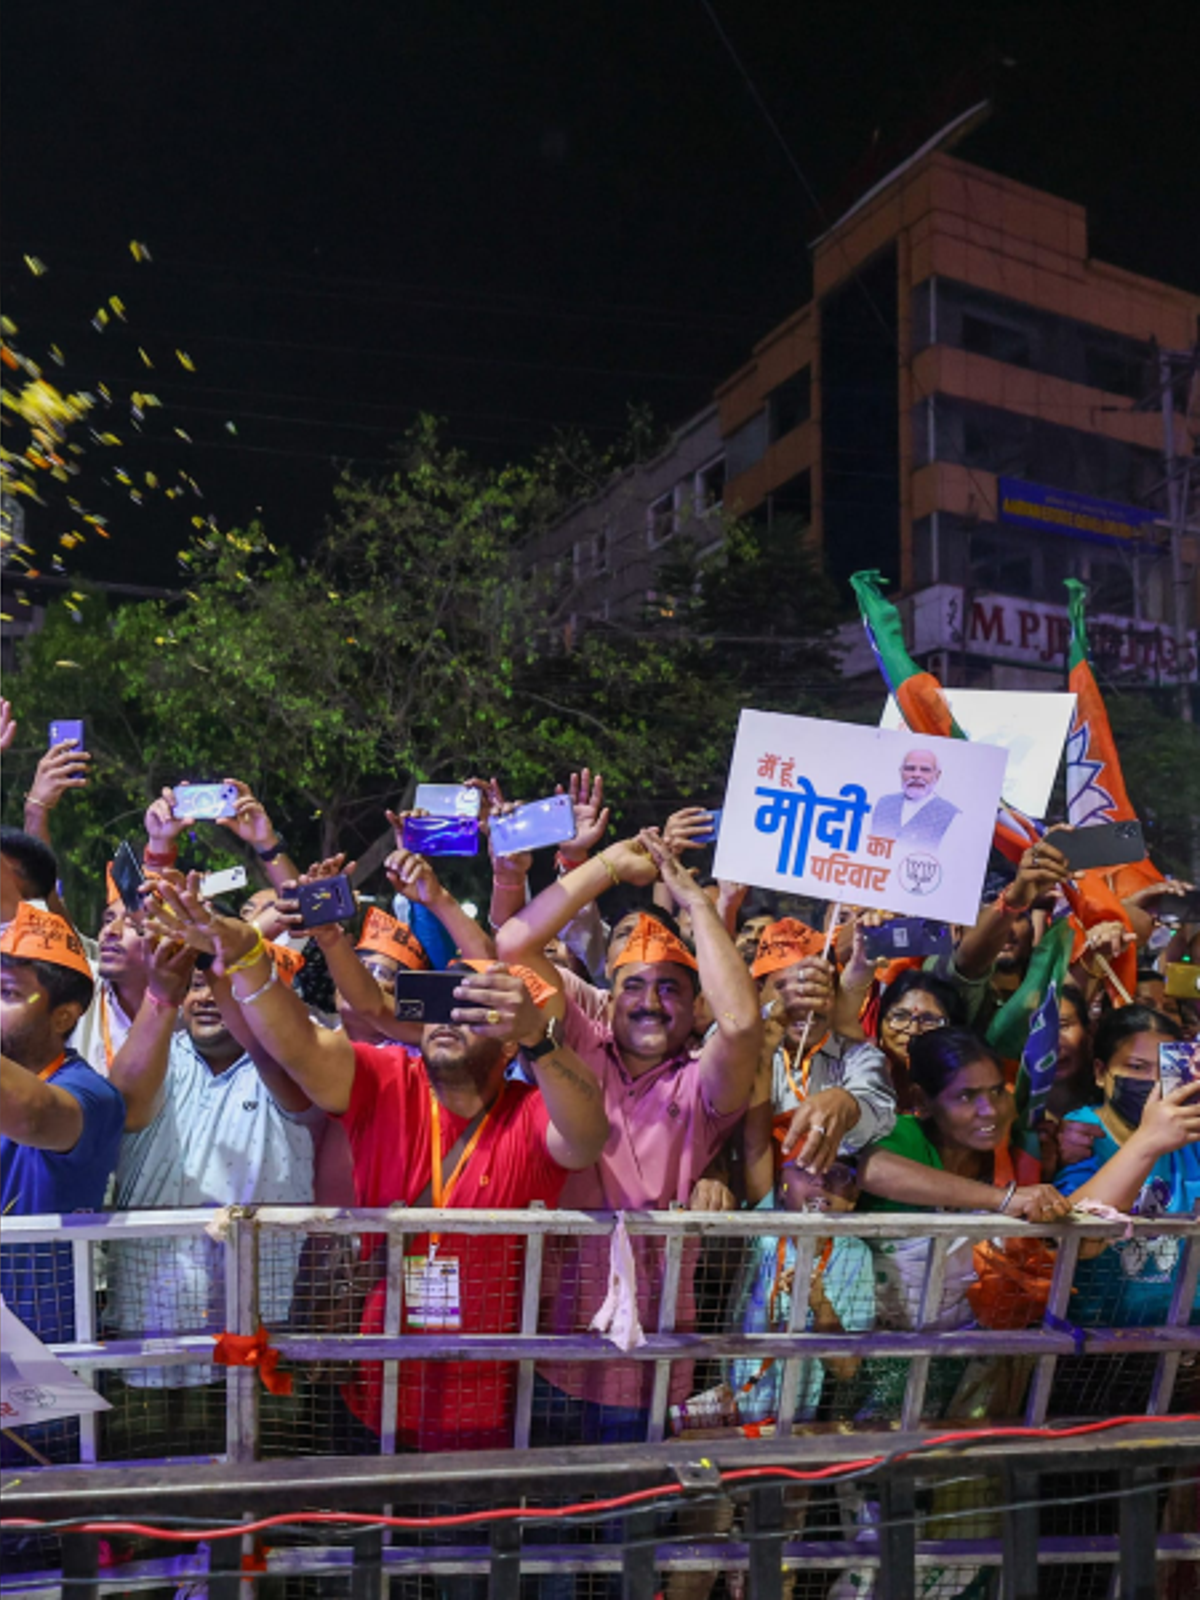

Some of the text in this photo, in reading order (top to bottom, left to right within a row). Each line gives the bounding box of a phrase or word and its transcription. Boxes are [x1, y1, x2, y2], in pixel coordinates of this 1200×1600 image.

[757, 752, 781, 780] मैं
[754, 775, 896, 878] मोदी का
[810, 852, 891, 892] परिवार
